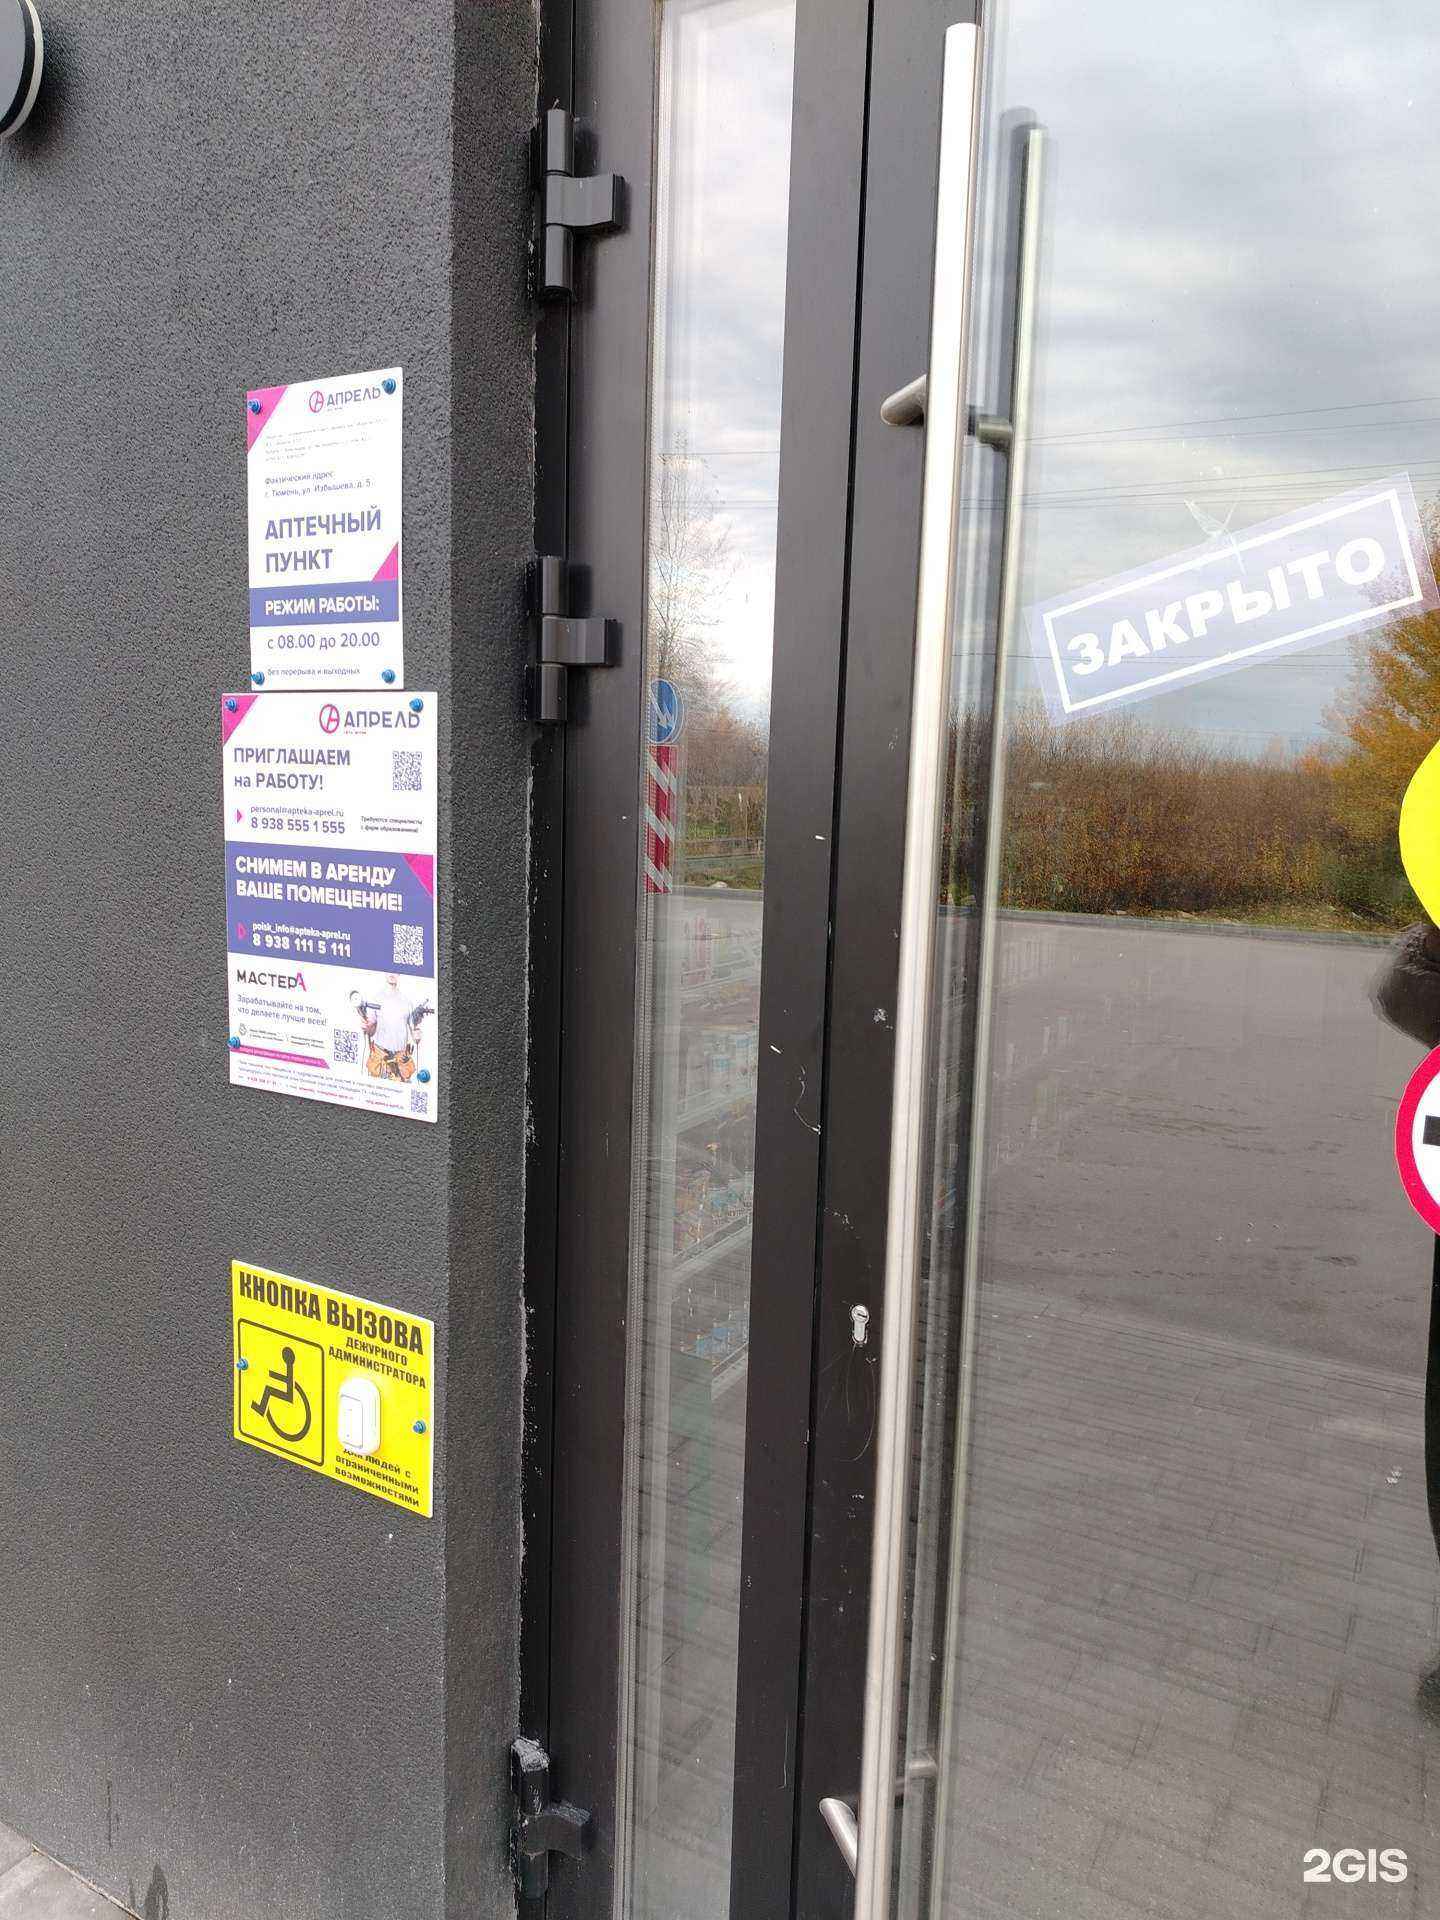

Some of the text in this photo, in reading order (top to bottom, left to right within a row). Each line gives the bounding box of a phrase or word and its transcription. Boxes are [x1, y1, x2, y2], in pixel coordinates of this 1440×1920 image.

[326, 387, 381, 407] АПРЕЛЬ
[265, 505, 381, 540] АПТЕЧНЫЙ
[265, 548, 333, 573] ПУНКТ
[265, 595, 380, 616] РЕЖИМ РАБОТЫ:
[1066, 537, 1386, 677] ЗАКРЫТО
[268, 632, 380, 650] с 08.00 до 20.00
[268, 668, 279, 676] без
[281, 668, 316, 677] перерыва
[324, 666, 361, 676] выходных
[344, 711, 420, 728] АПРЕЛЬ
[234, 748, 351, 766] ПРИГЛАШАЕМ
[234, 772, 324, 790] на РАБОТУ!
[251, 817, 346, 834] 8 938 555 1 555
[235, 856, 396, 887] СНИМЕМ В АРЕНДУ
[236, 880, 403, 912] ВАШЕ ПОМЕЩЕНИЕ!
[252, 934, 351, 958] 8 938 111 5 111
[236, 970, 307, 992] МАСТЕРА
[237, 994, 293, 1010] Зарабатывайте
[306, 1006, 322, 1014] том,
[251, 1010, 280, 1019] делаете
[282, 1014, 306, 1024] лучше
[308, 1018, 327, 1026] всех!
[239, 1271, 424, 1356] КНОПКА ВЫЗОВА
[346, 1336, 408, 1366] ДЕЖУРНОГО
[328, 1346, 426, 1389] АДМИНИСТРАТОРА
[336, 1455, 419, 1494] ограниченными
[364, 1454, 400, 1474] людей
[404, 1470, 412, 1479] с
[334, 1466, 420, 1507] возможностями
